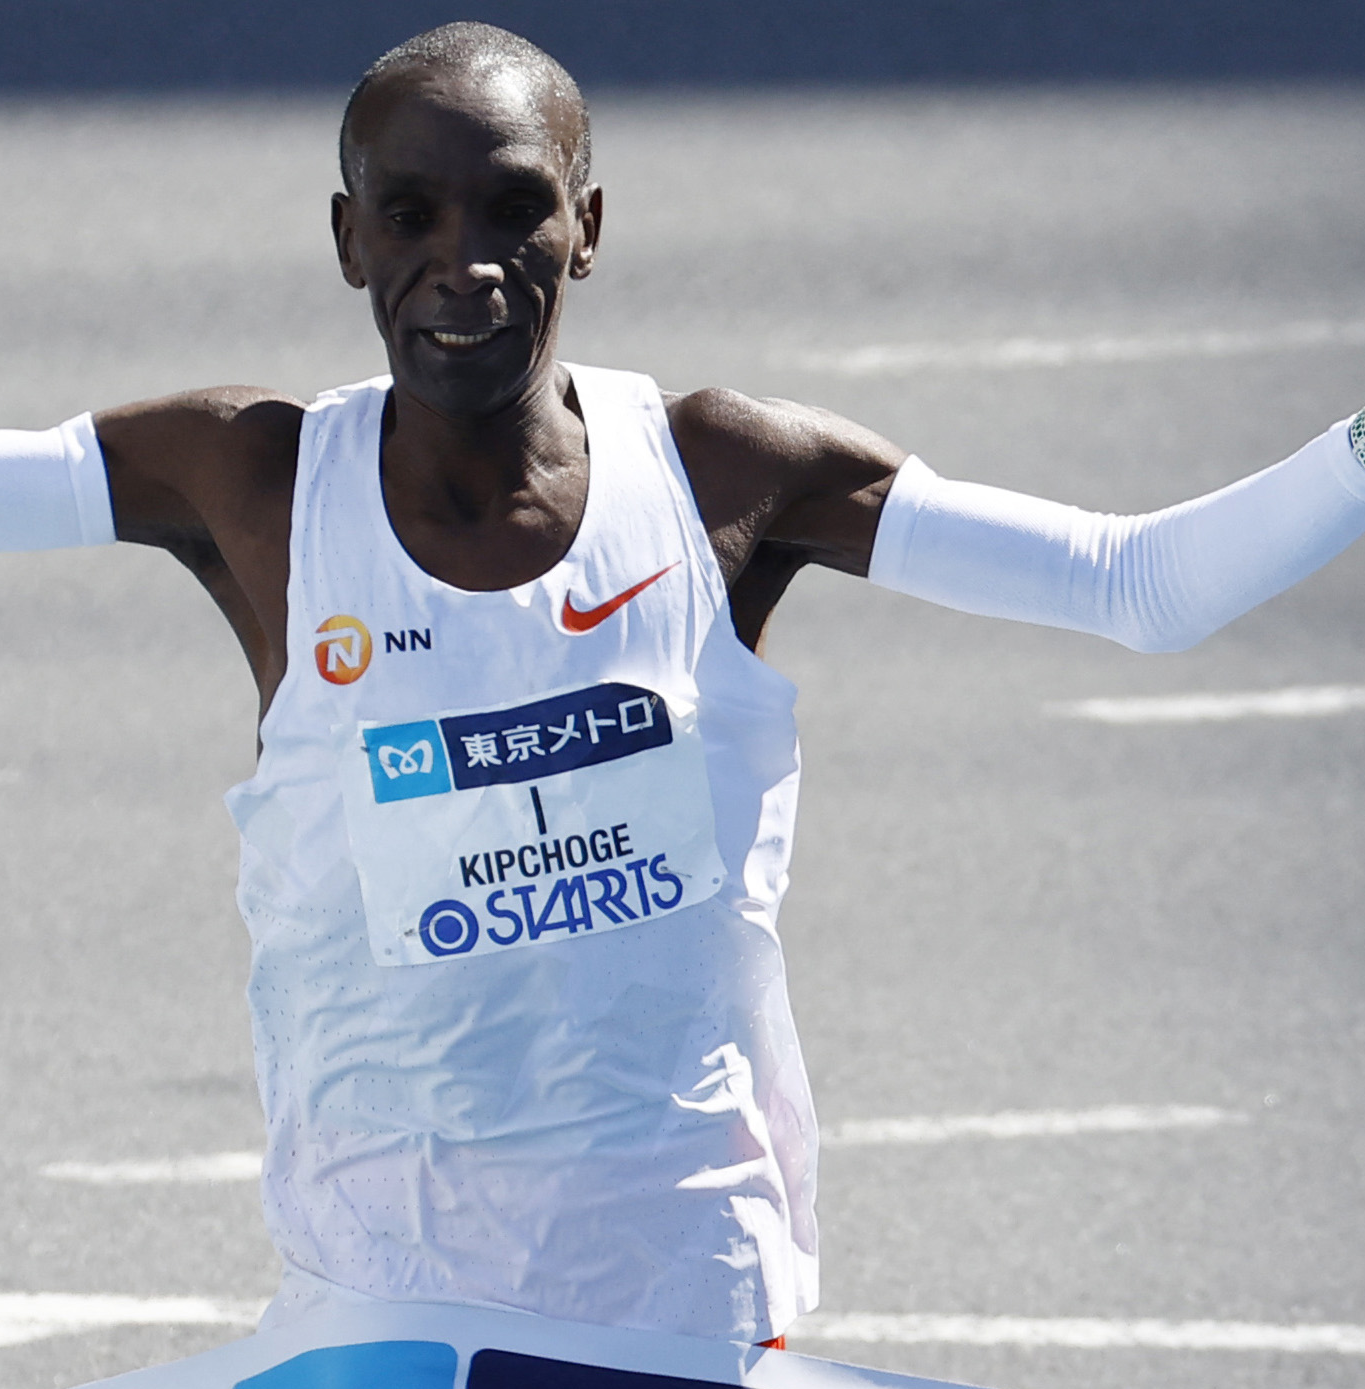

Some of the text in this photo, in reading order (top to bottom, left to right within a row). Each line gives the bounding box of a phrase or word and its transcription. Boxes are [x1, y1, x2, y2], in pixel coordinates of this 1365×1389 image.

[384, 628, 432, 653] NN
[460, 696, 654, 768] 東京メトロ
[459, 823, 634, 887] KIPCHOGE
